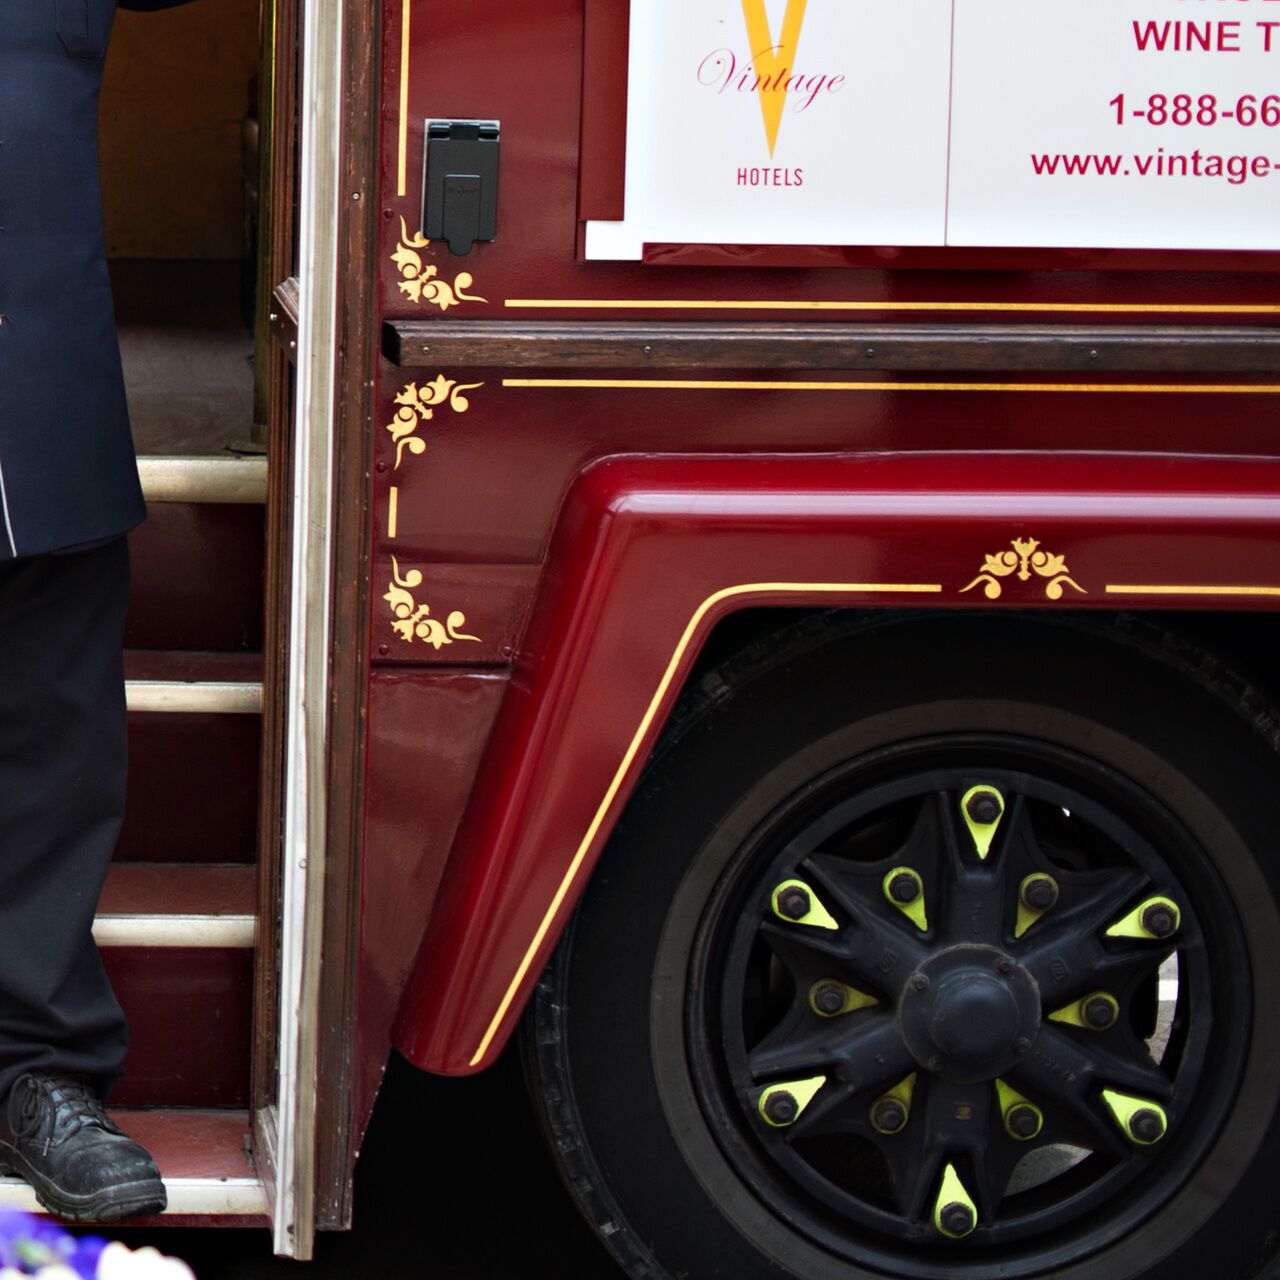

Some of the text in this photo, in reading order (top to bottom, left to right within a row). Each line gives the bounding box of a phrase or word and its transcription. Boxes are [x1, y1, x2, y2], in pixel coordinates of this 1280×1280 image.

[1132, 21, 1280, 52] WINE T
[697, 44, 846, 113] Vintage
[1109, 93, 1280, 127] 1-888-66
[737, 167, 803, 186] HOTELS
